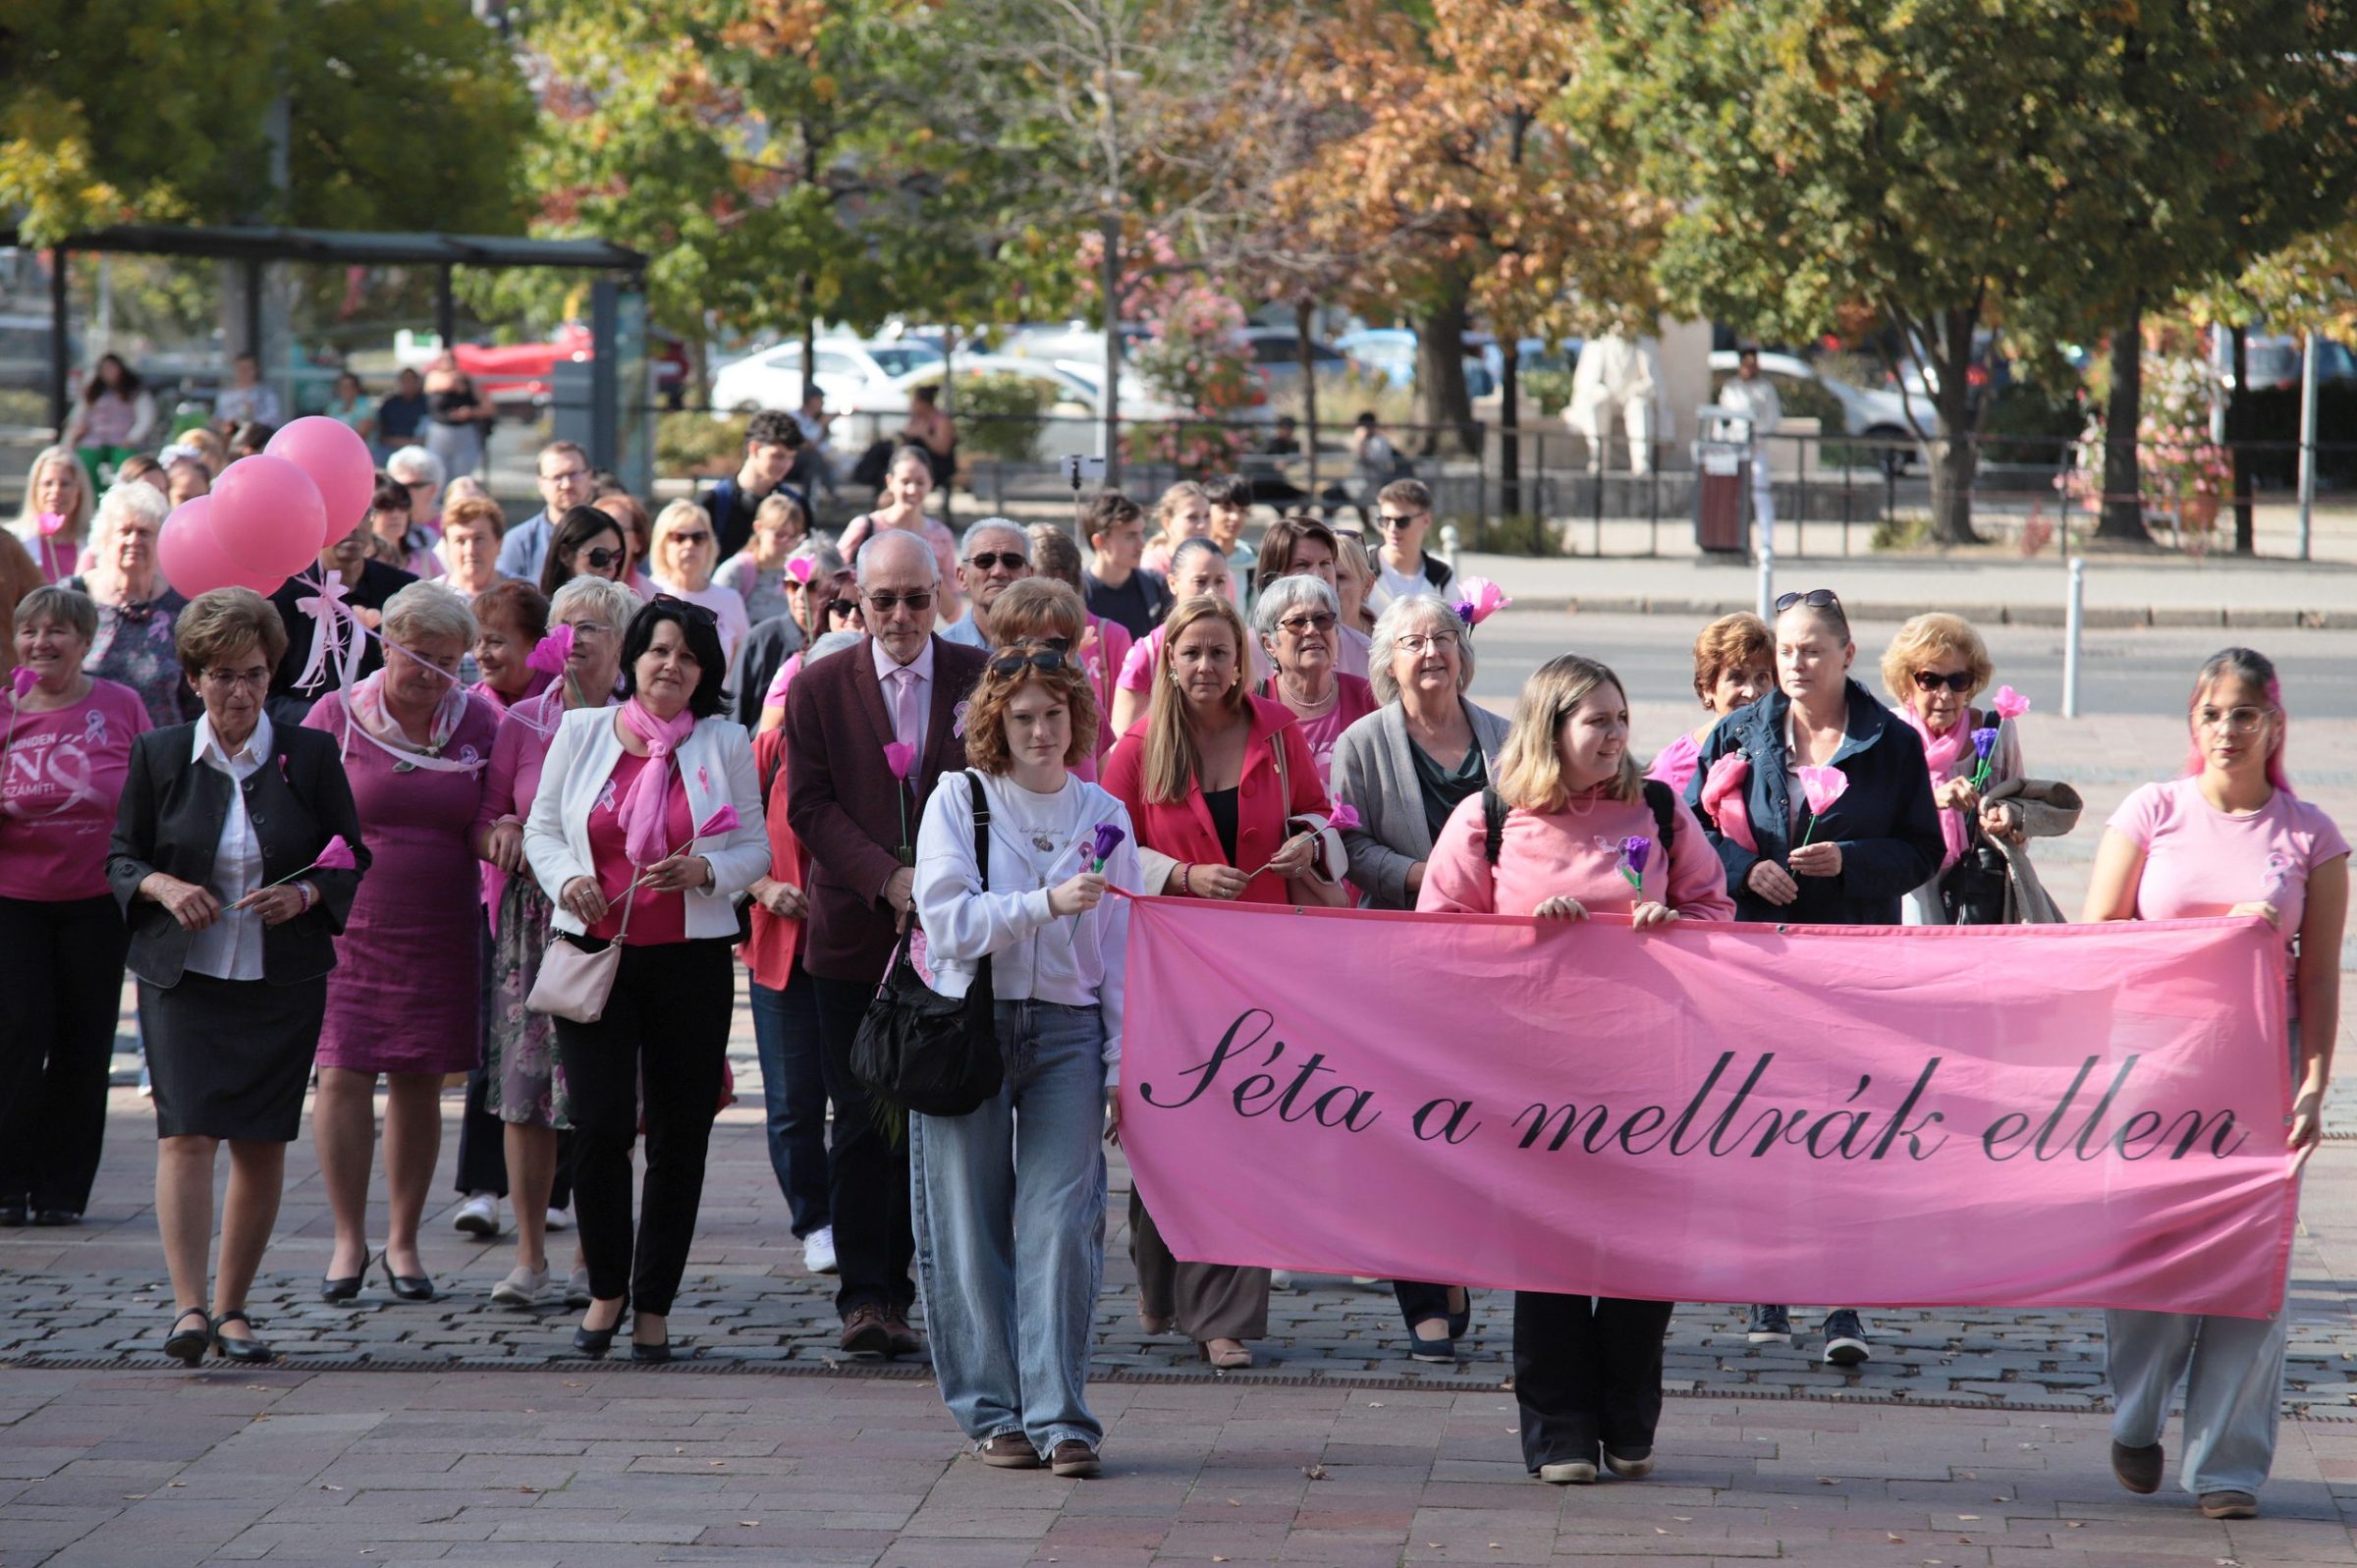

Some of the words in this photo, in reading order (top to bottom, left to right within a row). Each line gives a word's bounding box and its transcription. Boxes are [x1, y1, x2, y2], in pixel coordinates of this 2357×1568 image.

[9, 733, 57, 753] MINDEN
[2, 782, 56, 798] SZÁMÍT!
[1139, 1007, 1382, 1134] Séta
[1411, 1097, 1482, 1145] a
[1510, 1051, 1950, 1161] mellrák
[1981, 1054, 2251, 1162] ellen
